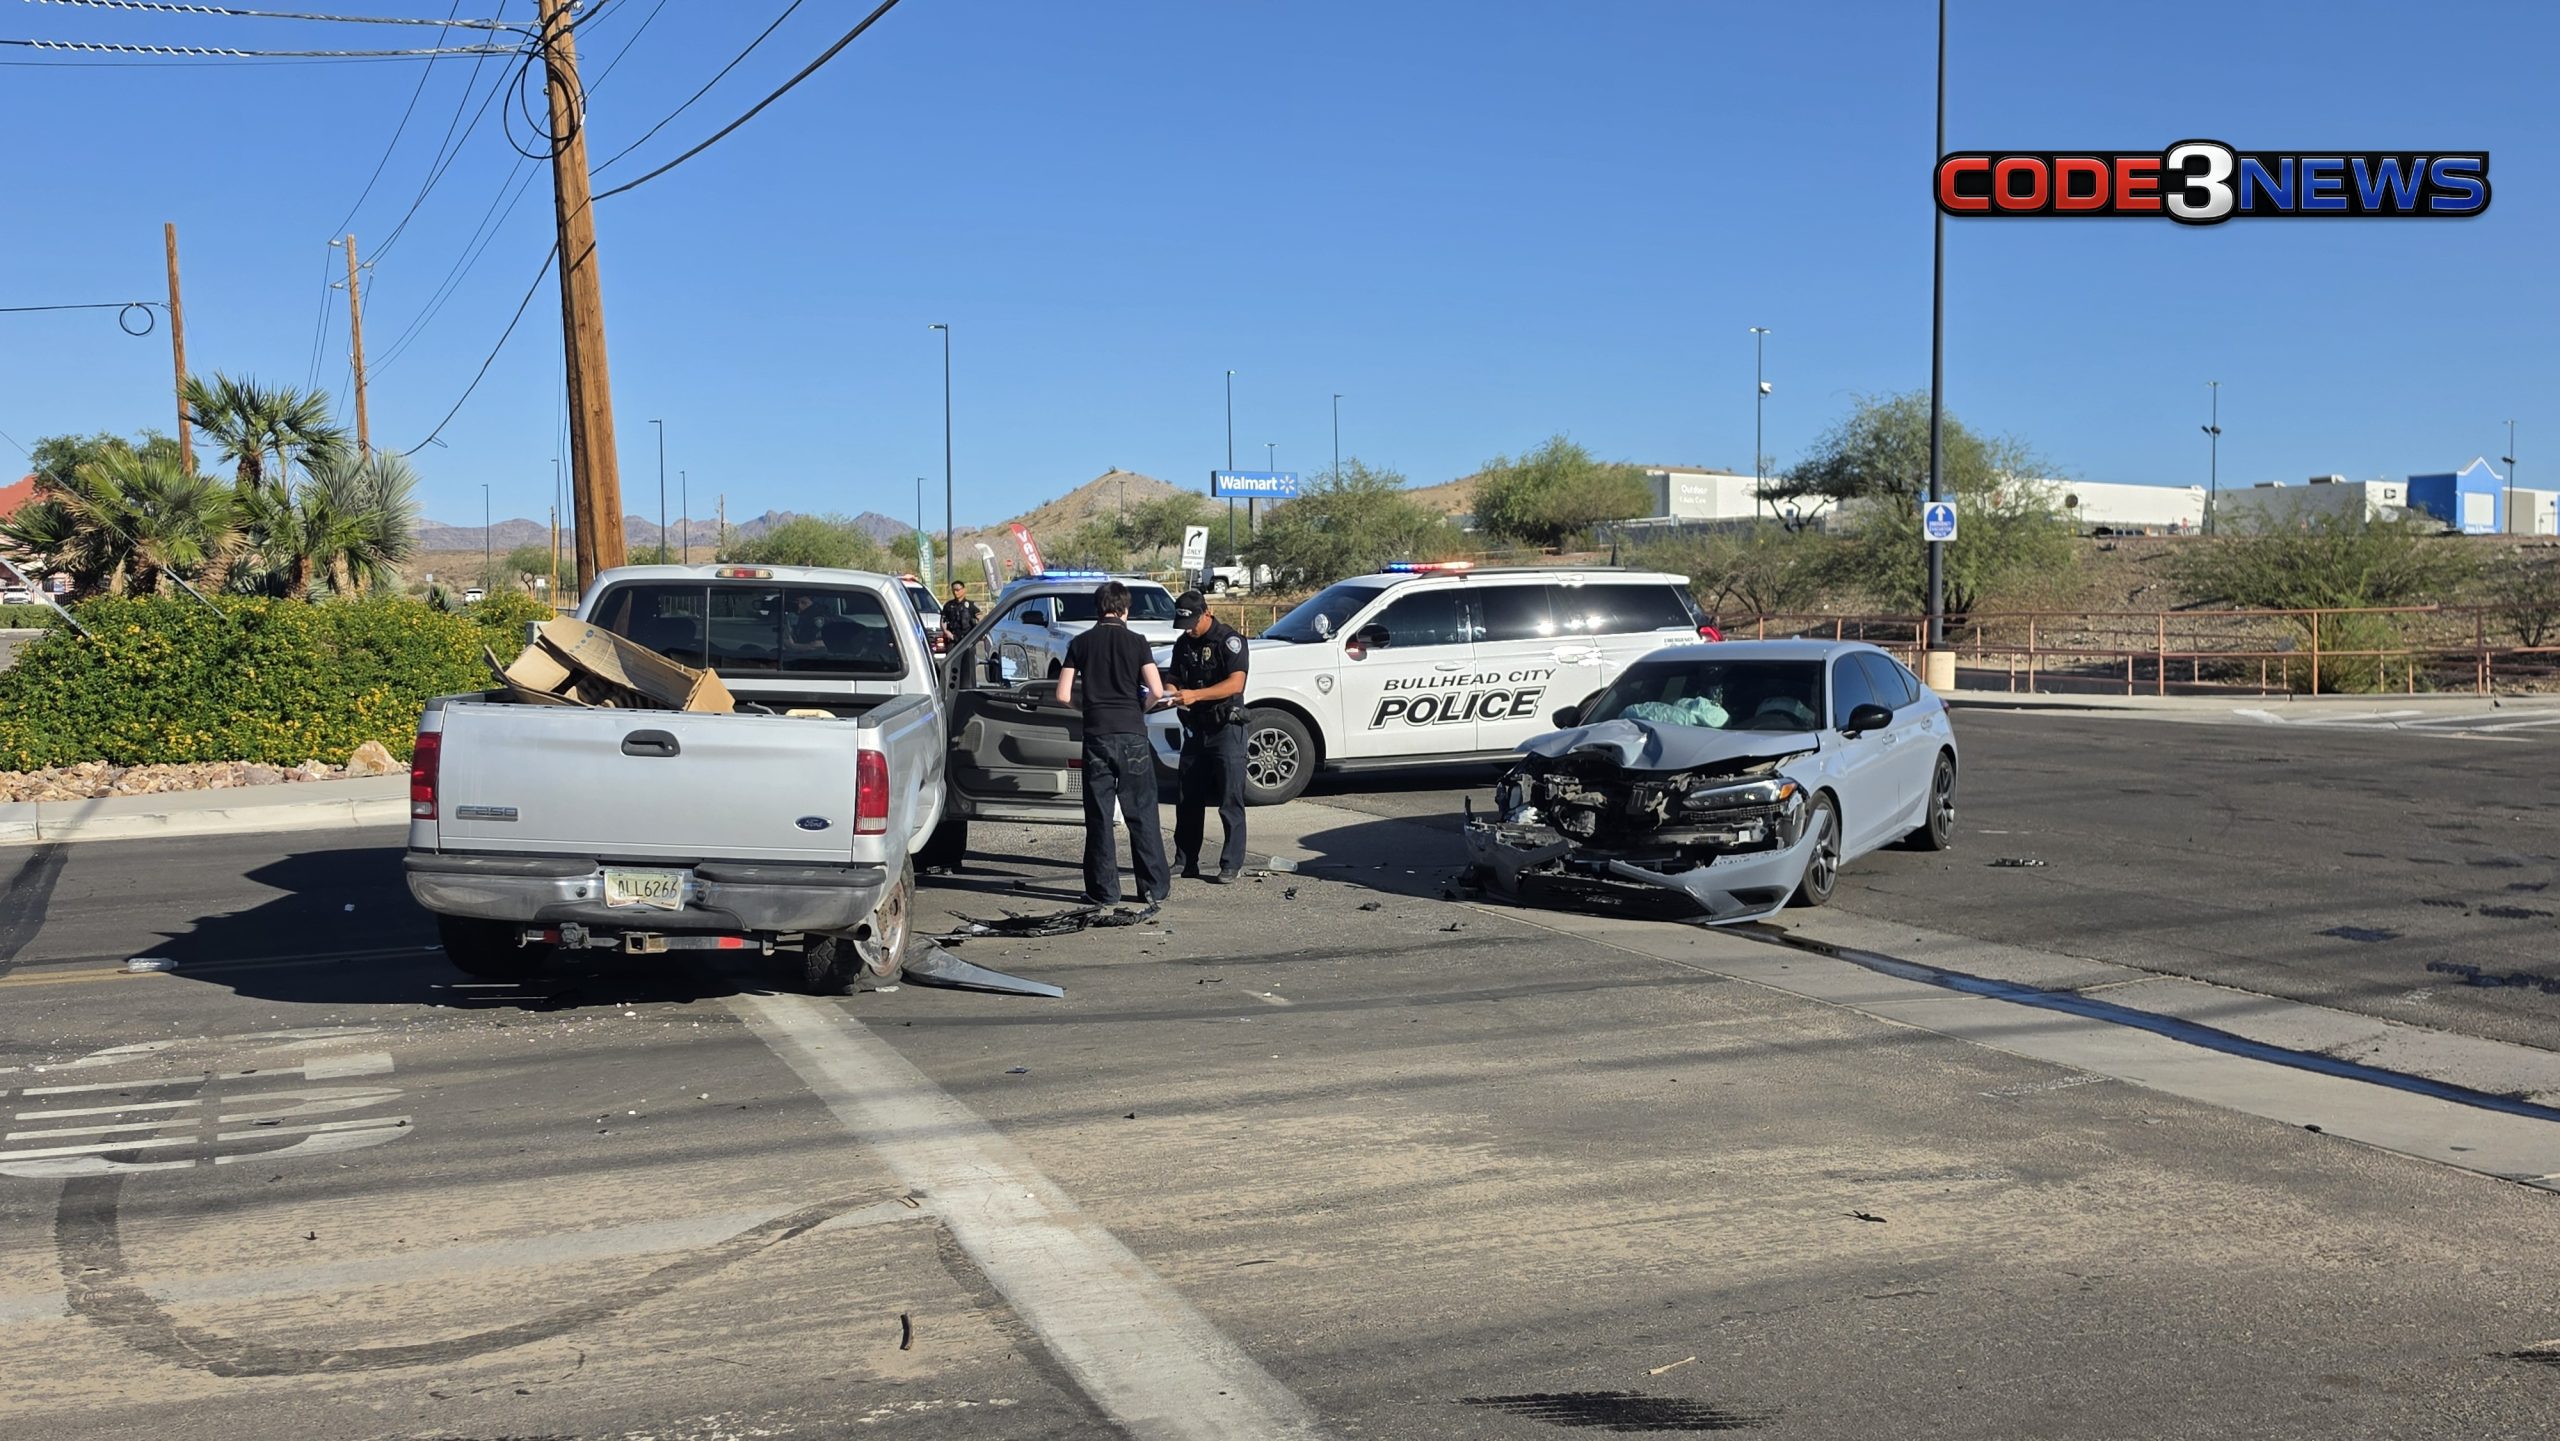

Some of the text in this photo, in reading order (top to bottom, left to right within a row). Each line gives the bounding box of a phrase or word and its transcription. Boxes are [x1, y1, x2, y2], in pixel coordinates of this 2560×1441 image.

[1219, 475, 1278, 491] Walmart
[1186, 547, 1202, 555] ONLY
[1384, 668, 1556, 691] BULLHEAD CITY
[1368, 686, 1546, 730] POLICE
